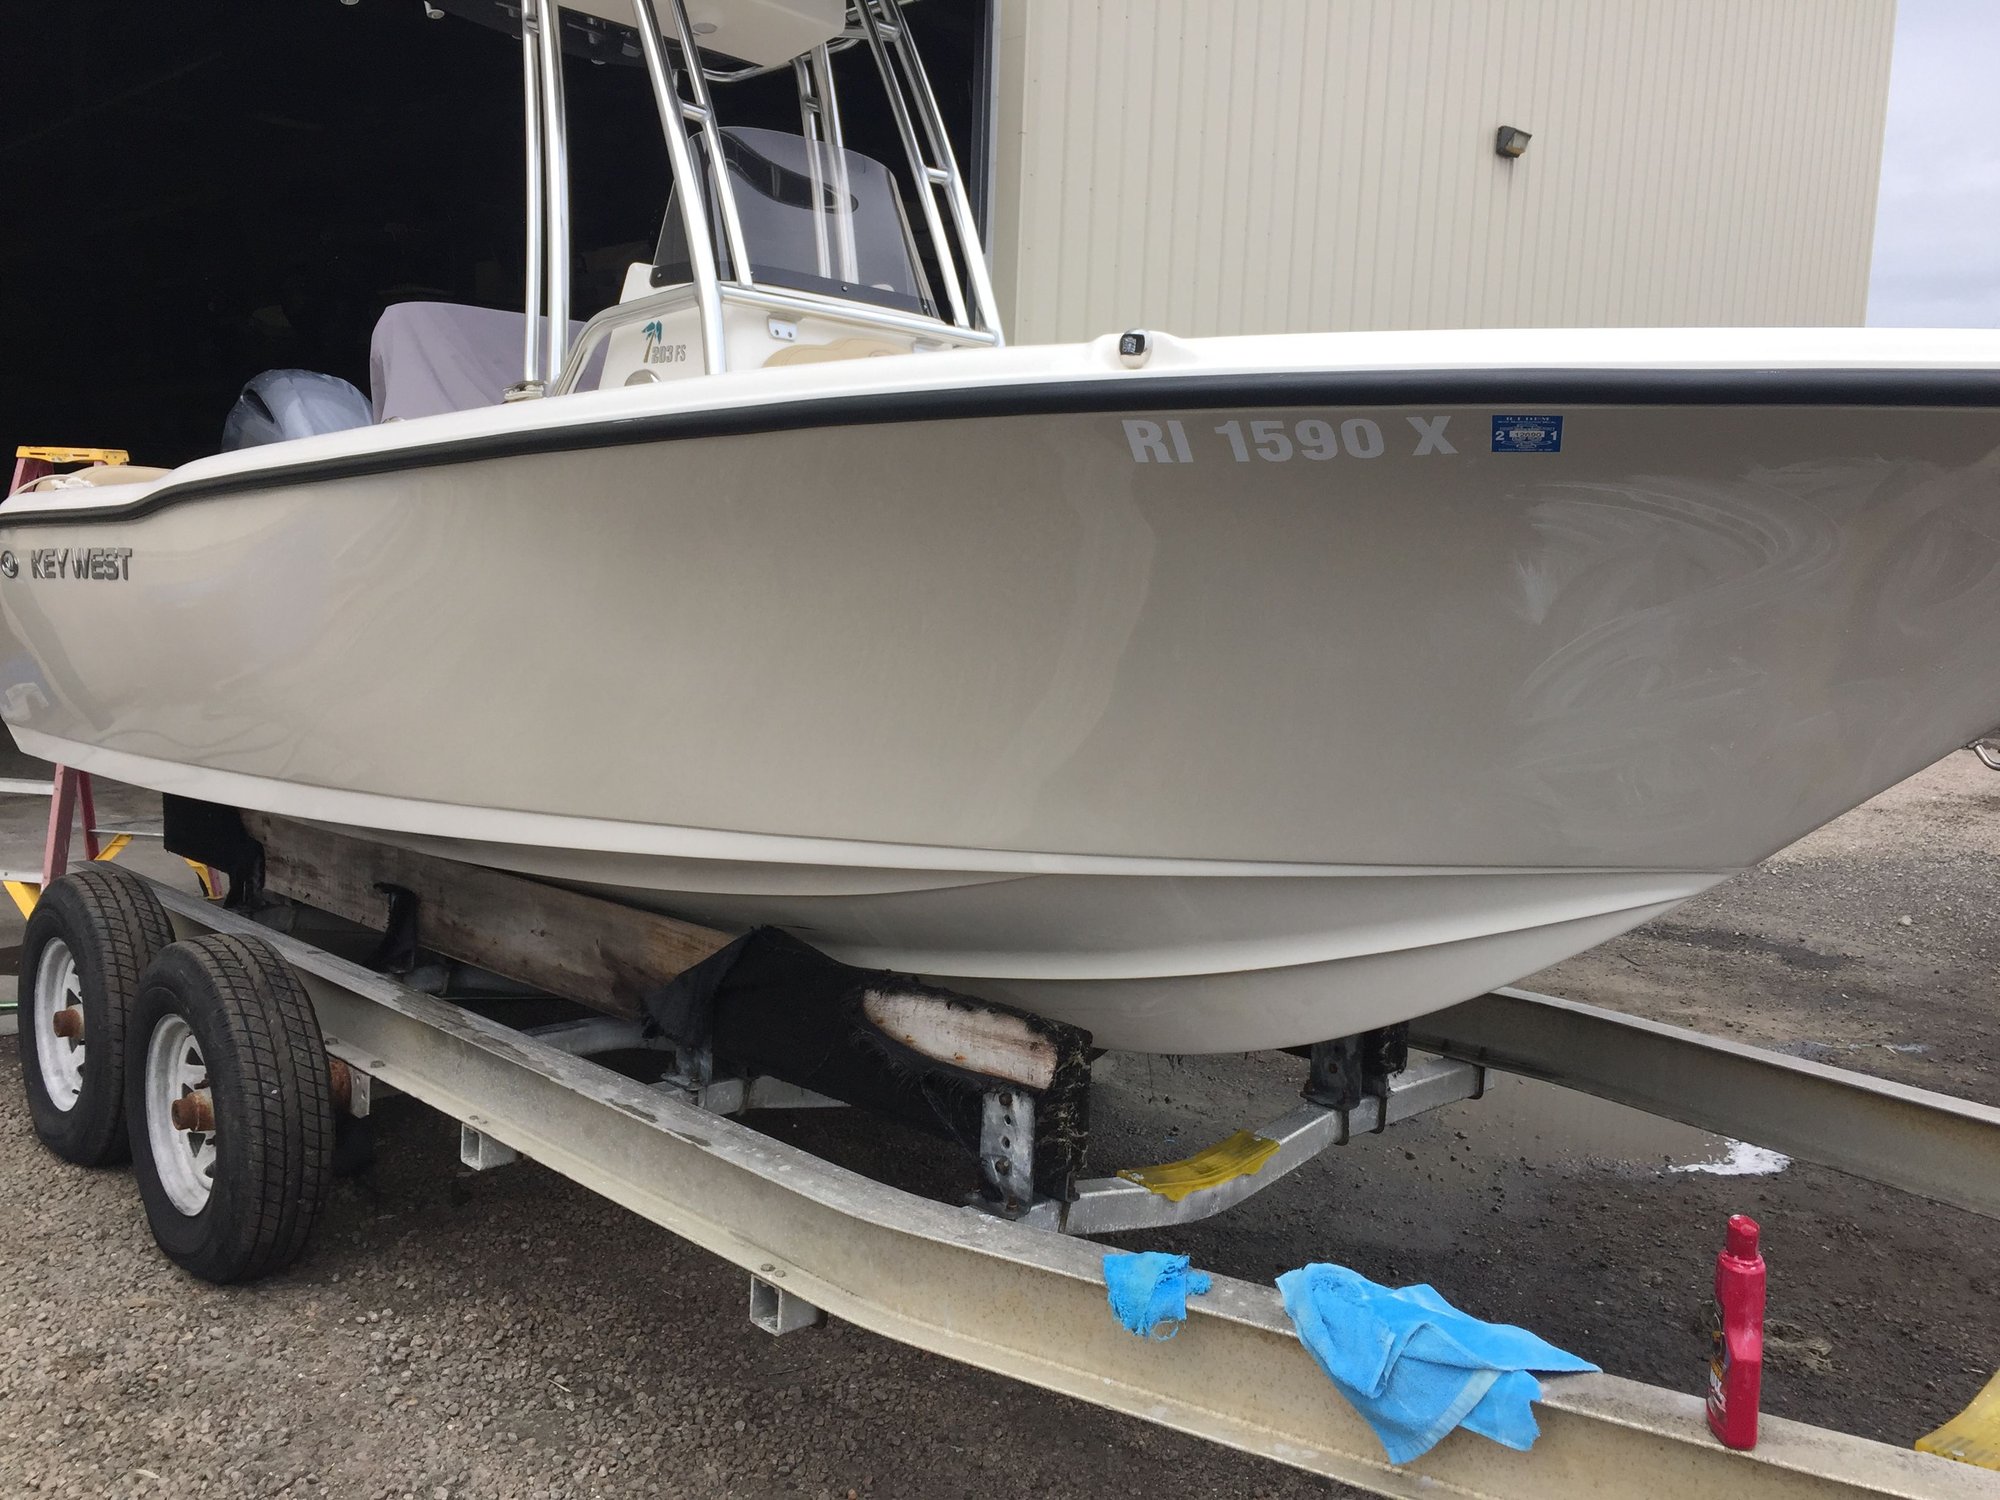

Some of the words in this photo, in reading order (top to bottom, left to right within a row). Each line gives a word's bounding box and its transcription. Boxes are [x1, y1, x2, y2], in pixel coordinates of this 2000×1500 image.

[675, 344, 687, 362] FS
[1122, 419, 1194, 463] RI
[1214, 418, 1384, 462] 1590
[1406, 415, 1459, 456] X
[1495, 430, 1505, 441] 2
[1550, 430, 1558, 441] 1
[31, 549, 69, 579] KEY
[71, 548, 132, 580] WEST
